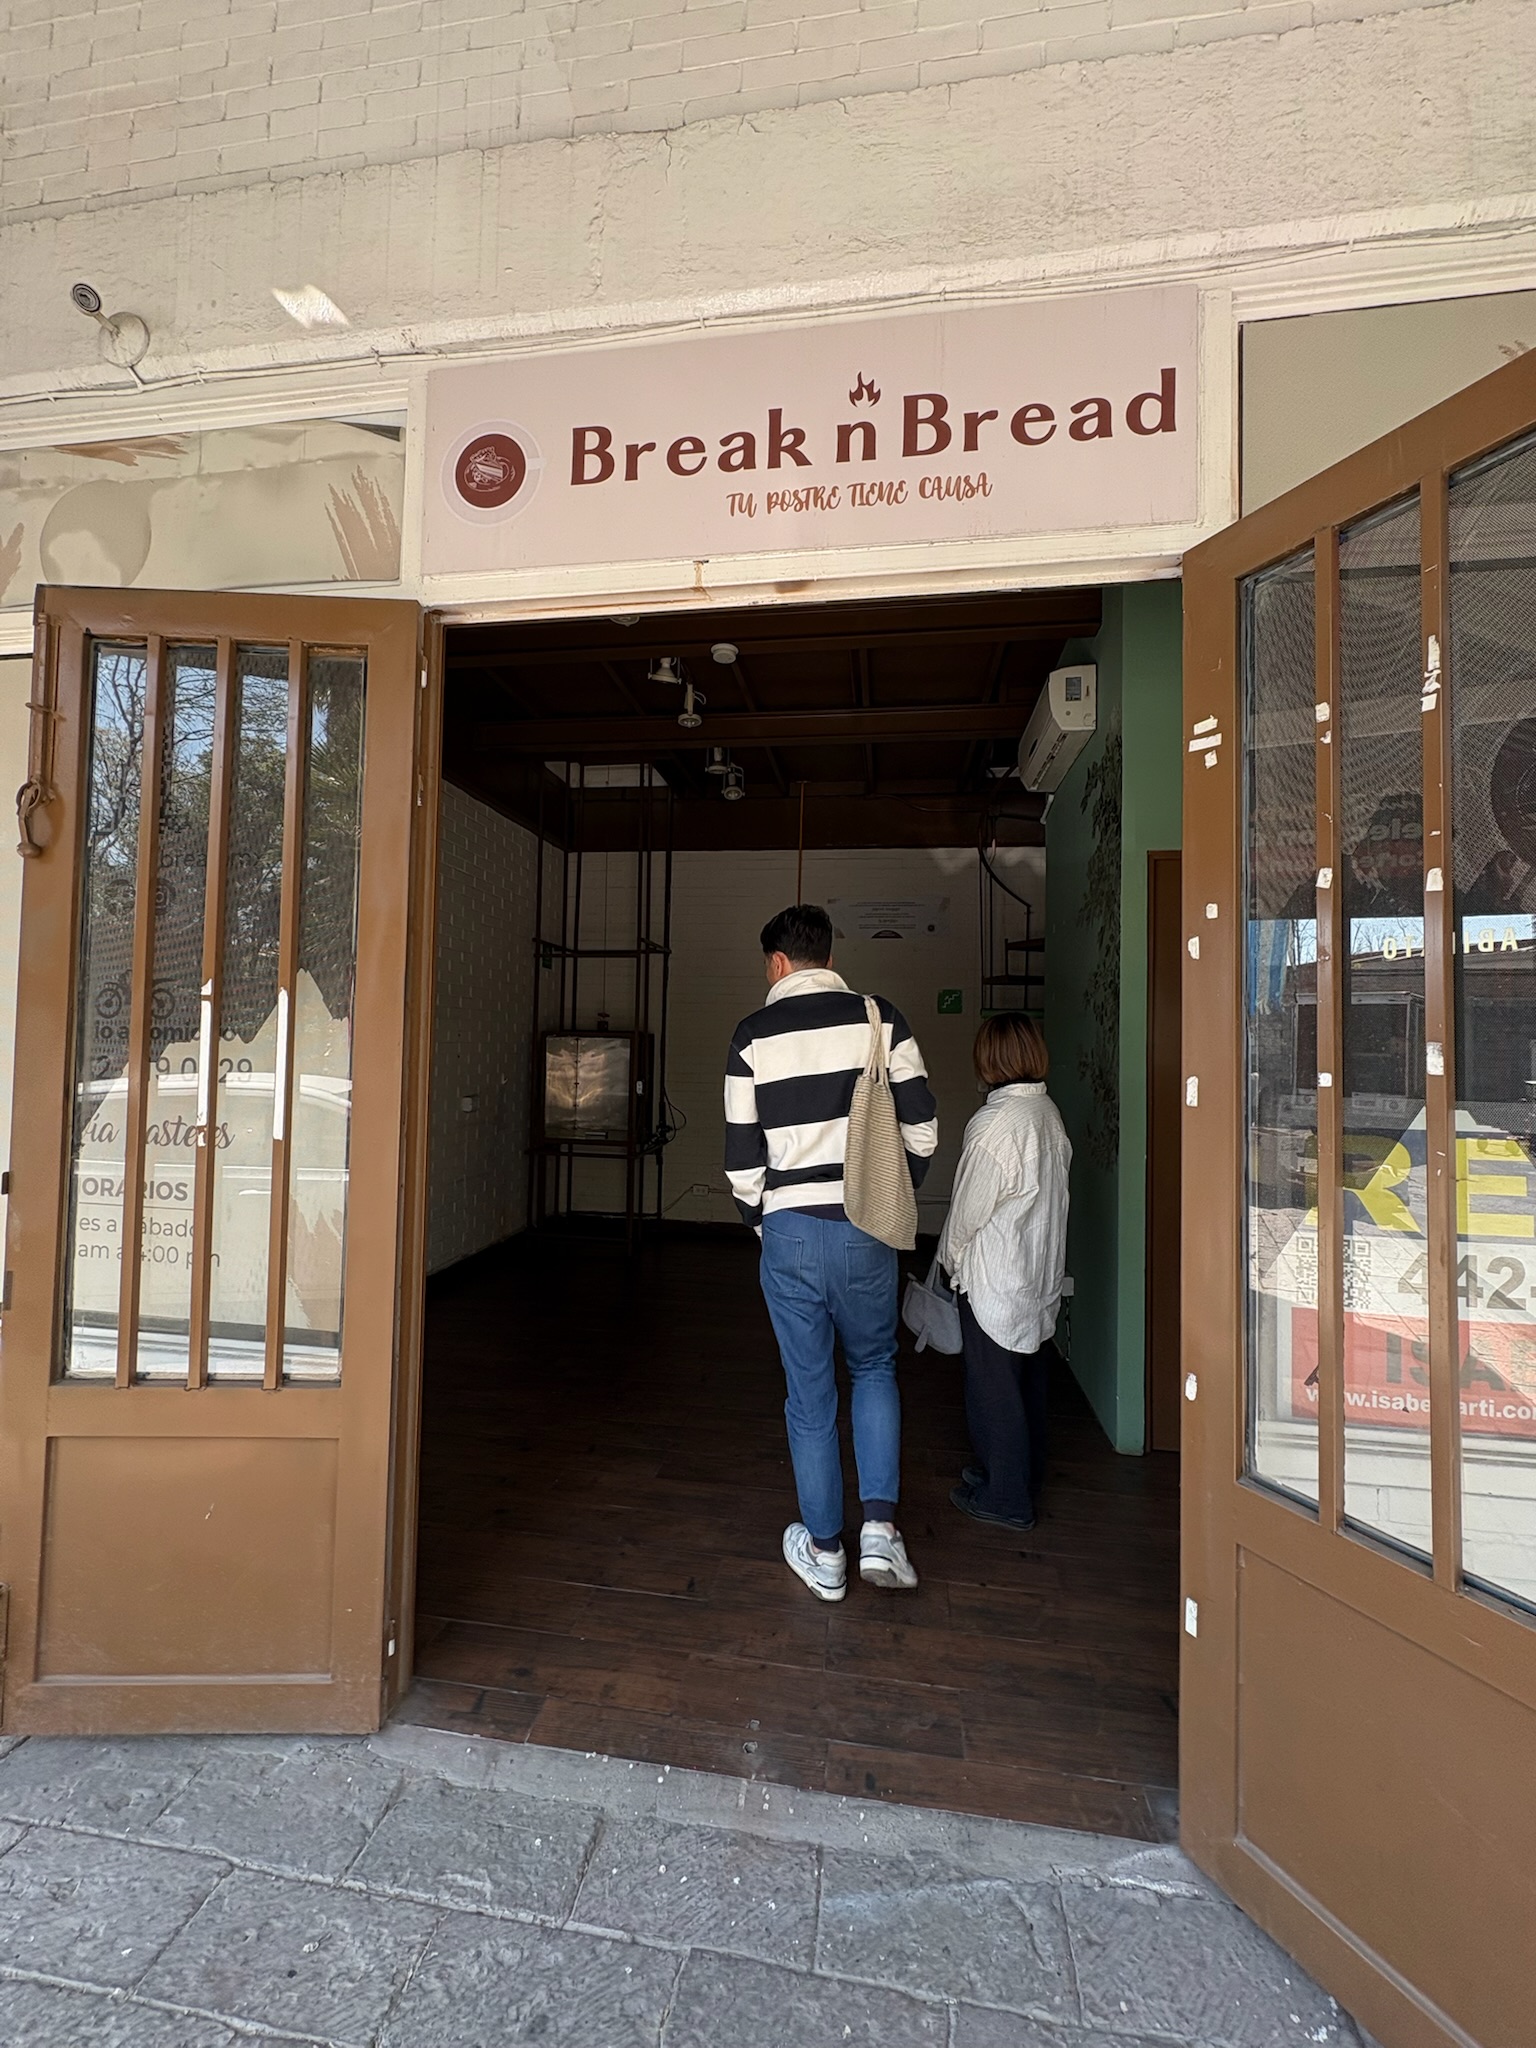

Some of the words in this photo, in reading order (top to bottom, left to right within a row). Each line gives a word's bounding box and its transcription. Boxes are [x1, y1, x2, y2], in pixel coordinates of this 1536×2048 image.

[570, 407, 813, 486] Break
[835, 421, 877, 463] n
[902, 367, 1177, 458] Bread
[726, 492, 757, 518] TU
[767, 485, 841, 514] POSTRE
[847, 479, 909, 507] TIENE
[918, 471, 994, 502] CAUSA
[82, 1176, 189, 1202] ORAIOS
[1398, 1251, 1536, 1311] 442
